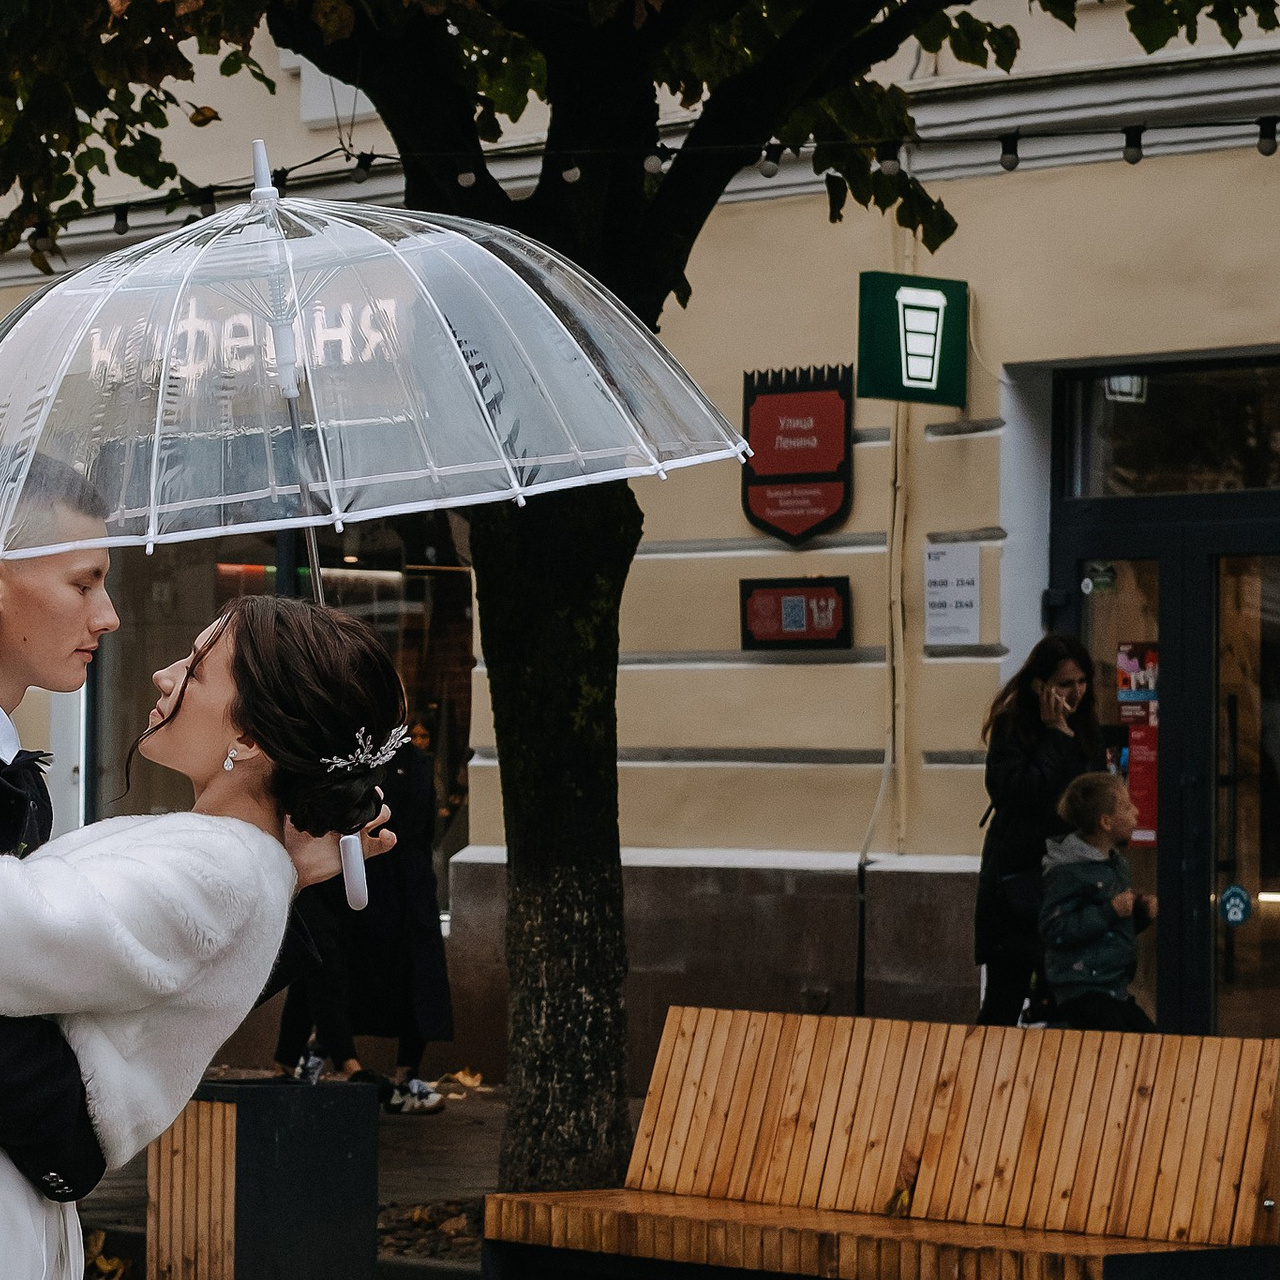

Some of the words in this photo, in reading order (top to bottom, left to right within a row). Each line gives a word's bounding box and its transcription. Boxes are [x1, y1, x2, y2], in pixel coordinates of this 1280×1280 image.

[88, 297, 398, 390] кфеня
[778, 416, 814, 431] Улица
[774, 435, 818, 450] Ленина
